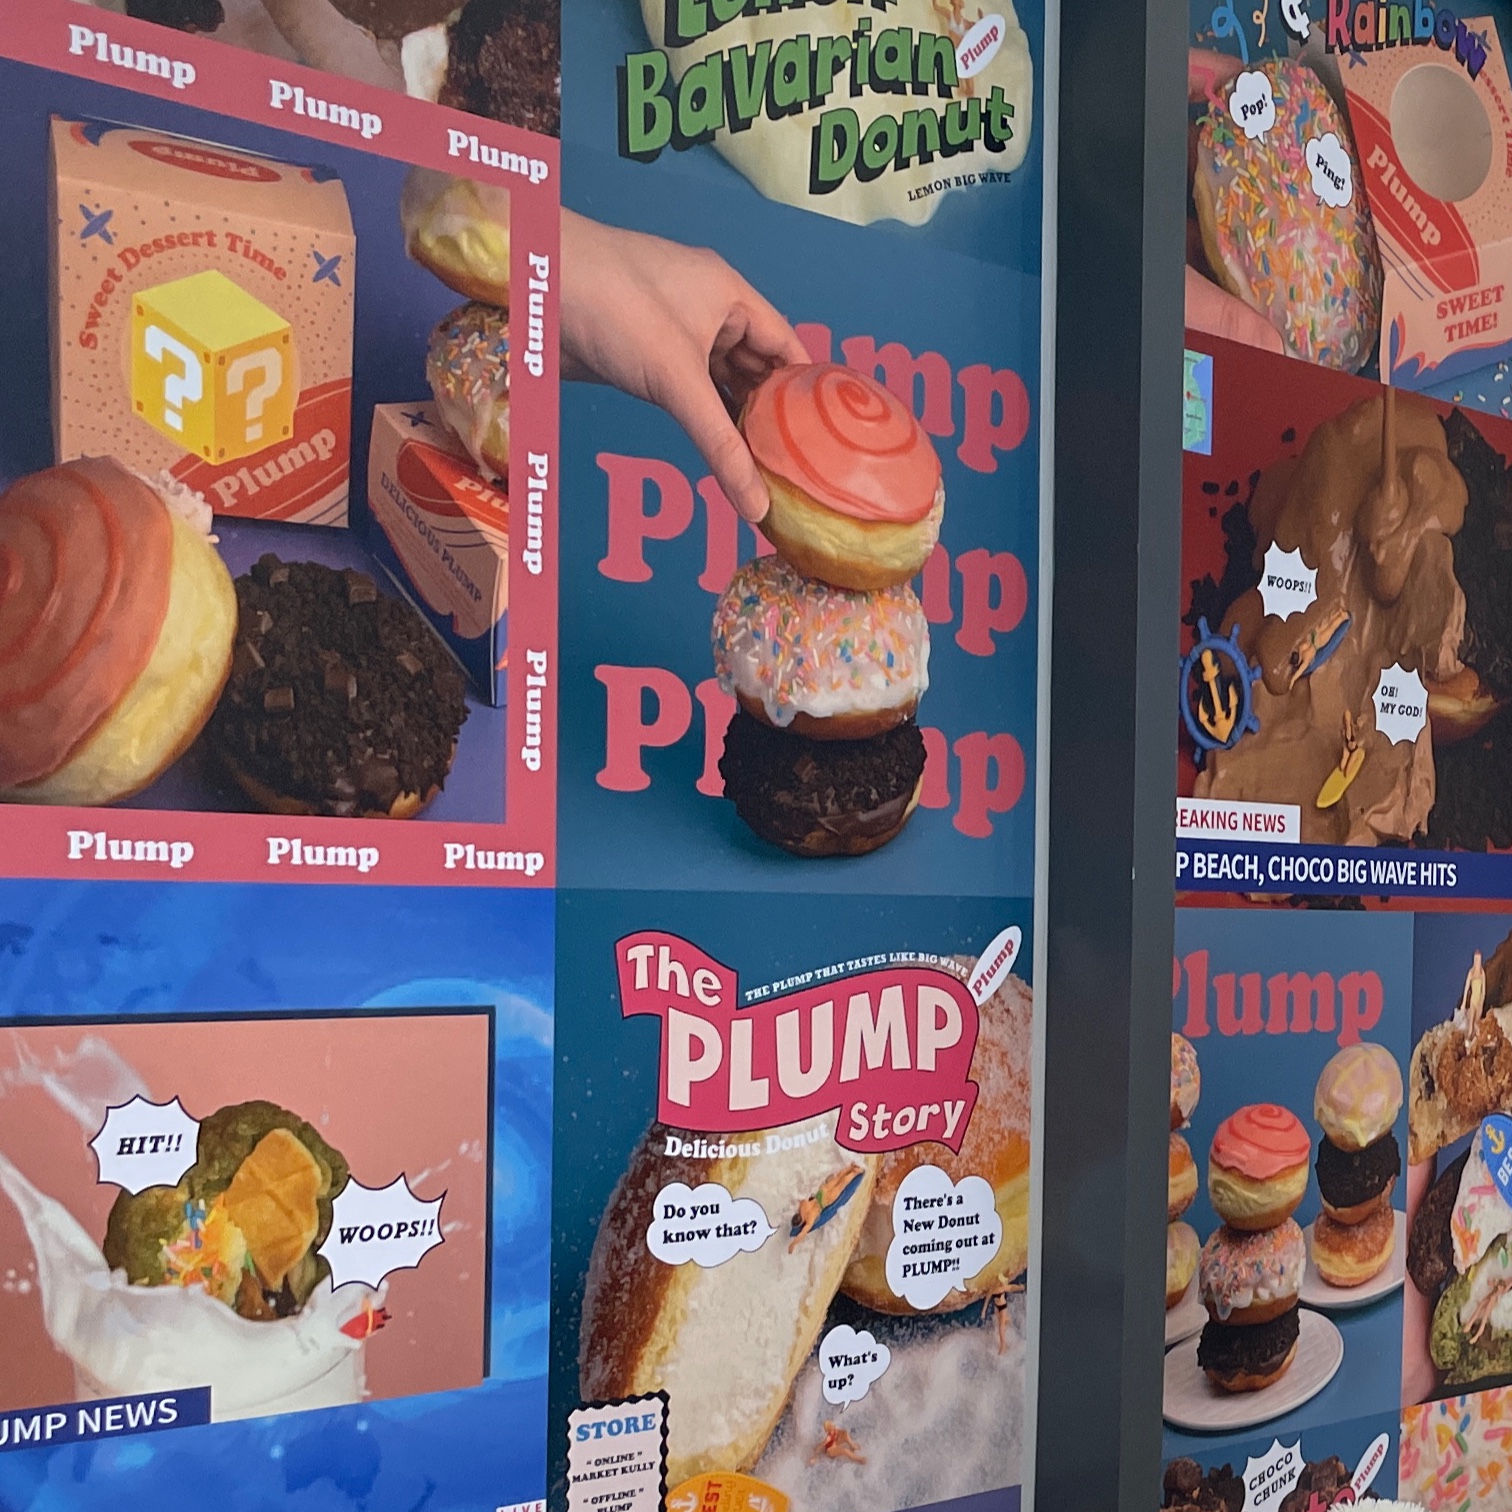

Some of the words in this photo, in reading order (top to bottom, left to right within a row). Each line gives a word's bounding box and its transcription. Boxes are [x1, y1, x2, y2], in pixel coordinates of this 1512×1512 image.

[68, 24, 196, 89] Plump
[959, 23, 999, 70] Plump
[620, 17, 959, 158] Bavarian
[268, 79, 383, 138] Plump
[1240, 94, 1269, 121] Pop!
[813, 85, 1014, 186] Donut
[447, 128, 549, 184] Plump
[1315, 153, 1346, 192] Ping!
[907, 180, 952, 202] LEMON
[954, 174, 977, 188] BIG
[978, 172, 1011, 185] WAVE
[1366, 144, 1442, 246] Plump
[79, 268, 123, 351] Sweet
[117, 228, 217, 267] Dessert
[225, 232, 288, 282] Time
[1435, 285, 1505, 320] SWEET
[525, 252, 549, 379] Plump
[1443, 313, 1499, 344] TIME!
[210, 427, 337, 508] Plump
[522, 451, 548, 576] Plump
[380, 471, 440, 555] DELICIOUS
[441, 549, 483, 603] PLUMP
[1266, 573, 1312, 595] WOOPS!!
[521, 649, 547, 772] Plump
[1380, 685, 1398, 698] OH!
[1380, 701, 1396, 716] MY
[1398, 704, 1424, 719] GOD!
[1176, 808, 1238, 830] EAKING
[1242, 813, 1286, 833] NEWS
[67, 830, 194, 868] Plump
[266, 836, 379, 872] Plump
[443, 843, 545, 876] Plump
[1193, 853, 1265, 886] BEACH,
[1268, 856, 1334, 883] CHOCO
[1337, 859, 1367, 884] BIG
[1369, 860, 1418, 885] WAVE
[1420, 862, 1458, 887] HITS
[627, 943, 723, 1006] The
[745, 985, 770, 1002] THE
[772, 970, 813, 995] PLUMP
[815, 963, 845, 980] THAT
[846, 954, 887, 972] TASTES
[889, 951, 915, 963] LIKE
[918, 952, 938, 965] BIG
[939, 956, 969, 978] WAVE
[970, 937, 1015, 997] Plump
[666, 983, 964, 1112] PLUMP
[848, 1098, 966, 1143] Story
[116, 1132, 183, 1155] HIT!!
[663, 1135, 762, 1160] Delicious
[764, 1122, 830, 1154] Donut
[662, 1203, 685, 1220] Do
[689, 1202, 720, 1223] you
[903, 1193, 950, 1212] There's
[954, 1195, 964, 1205] a
[338, 1218, 436, 1245] WOOPS!!
[662, 1227, 706, 1246] know
[708, 1219, 758, 1239] that?
[903, 1216, 934, 1234] New
[937, 1212, 980, 1231] Donut
[901, 1238, 953, 1258] coming
[954, 1236, 978, 1250] out
[981, 1233, 996, 1247] at
[901, 1257, 960, 1279] PLUMP!!
[827, 1349, 879, 1370] What's
[827, 1373, 854, 1392] up?
[78, 1398, 178, 1436] NEWS
[576, 1413, 656, 1444] STORE
[572, 1468, 619, 1484] MARKET
[1248, 1452, 1294, 1491] CHOCO
[1354, 1441, 1386, 1490] Plump
[1253, 1468, 1298, 1508] CHUNK
